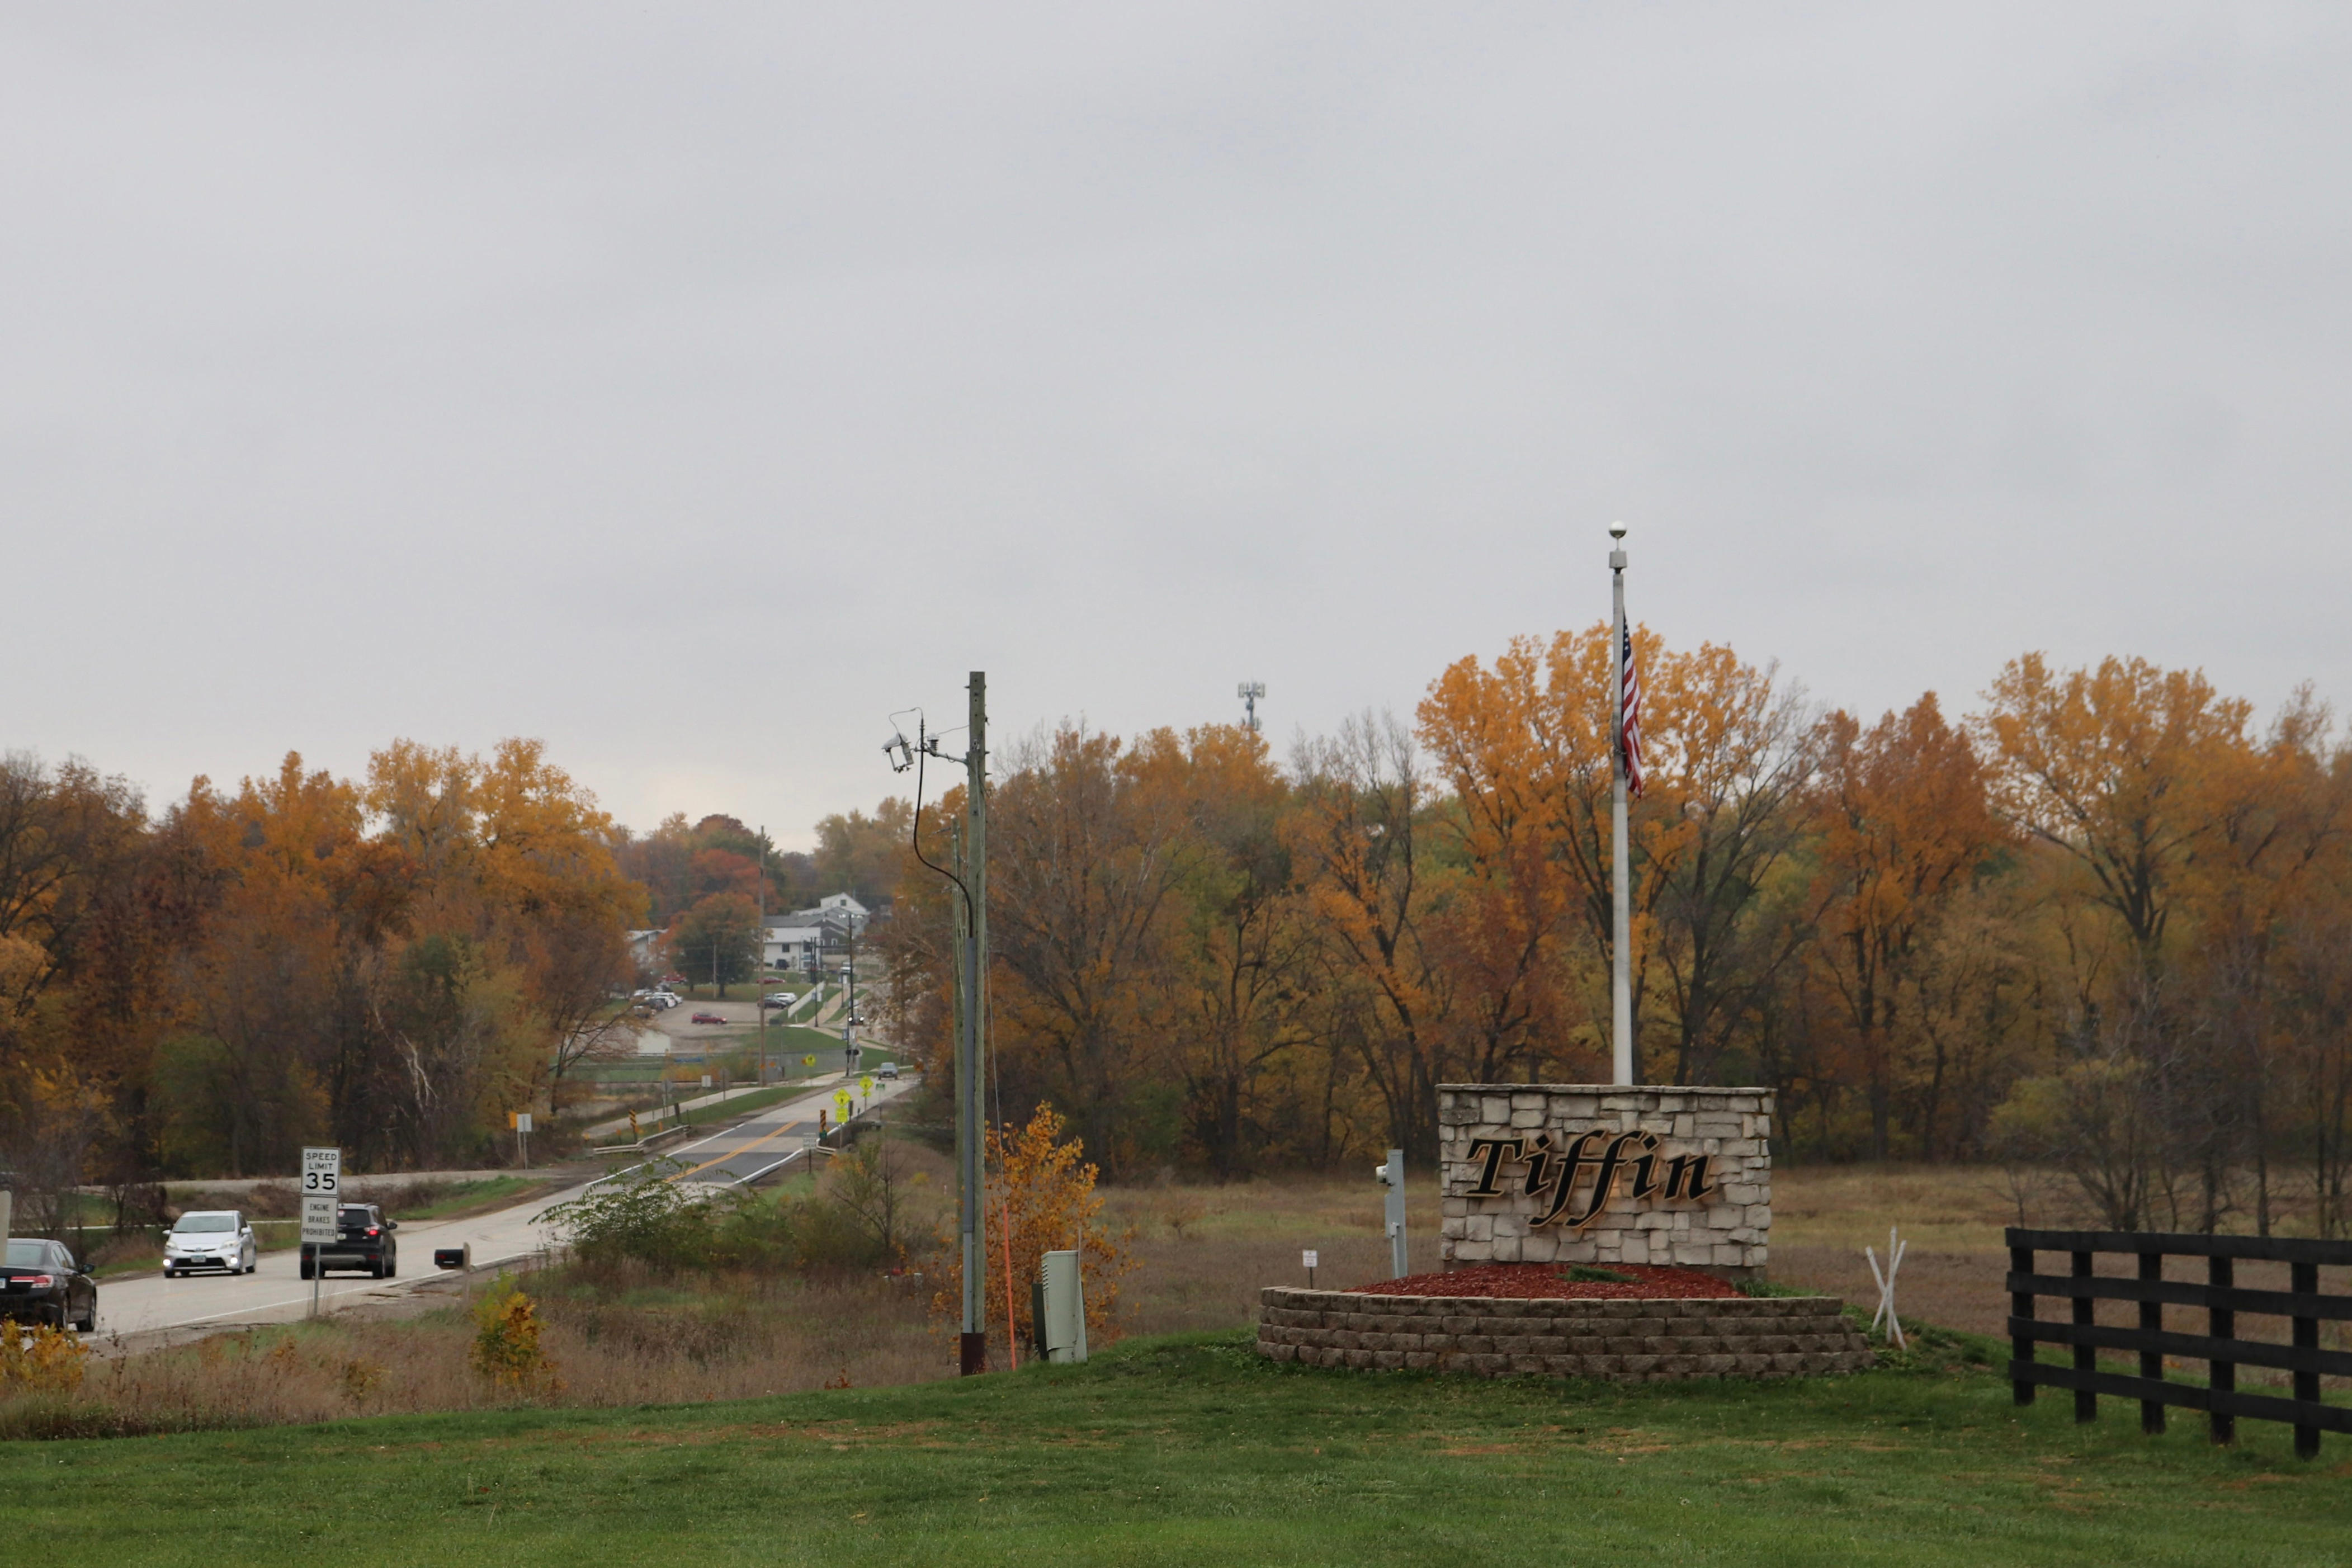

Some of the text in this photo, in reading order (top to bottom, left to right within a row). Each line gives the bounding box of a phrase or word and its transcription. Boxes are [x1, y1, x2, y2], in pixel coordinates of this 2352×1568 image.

[306, 1173, 335, 1190] 35
[1466, 1128, 1713, 1228] Tiffin
[302, 1227, 334, 1236] PROHIBITED
